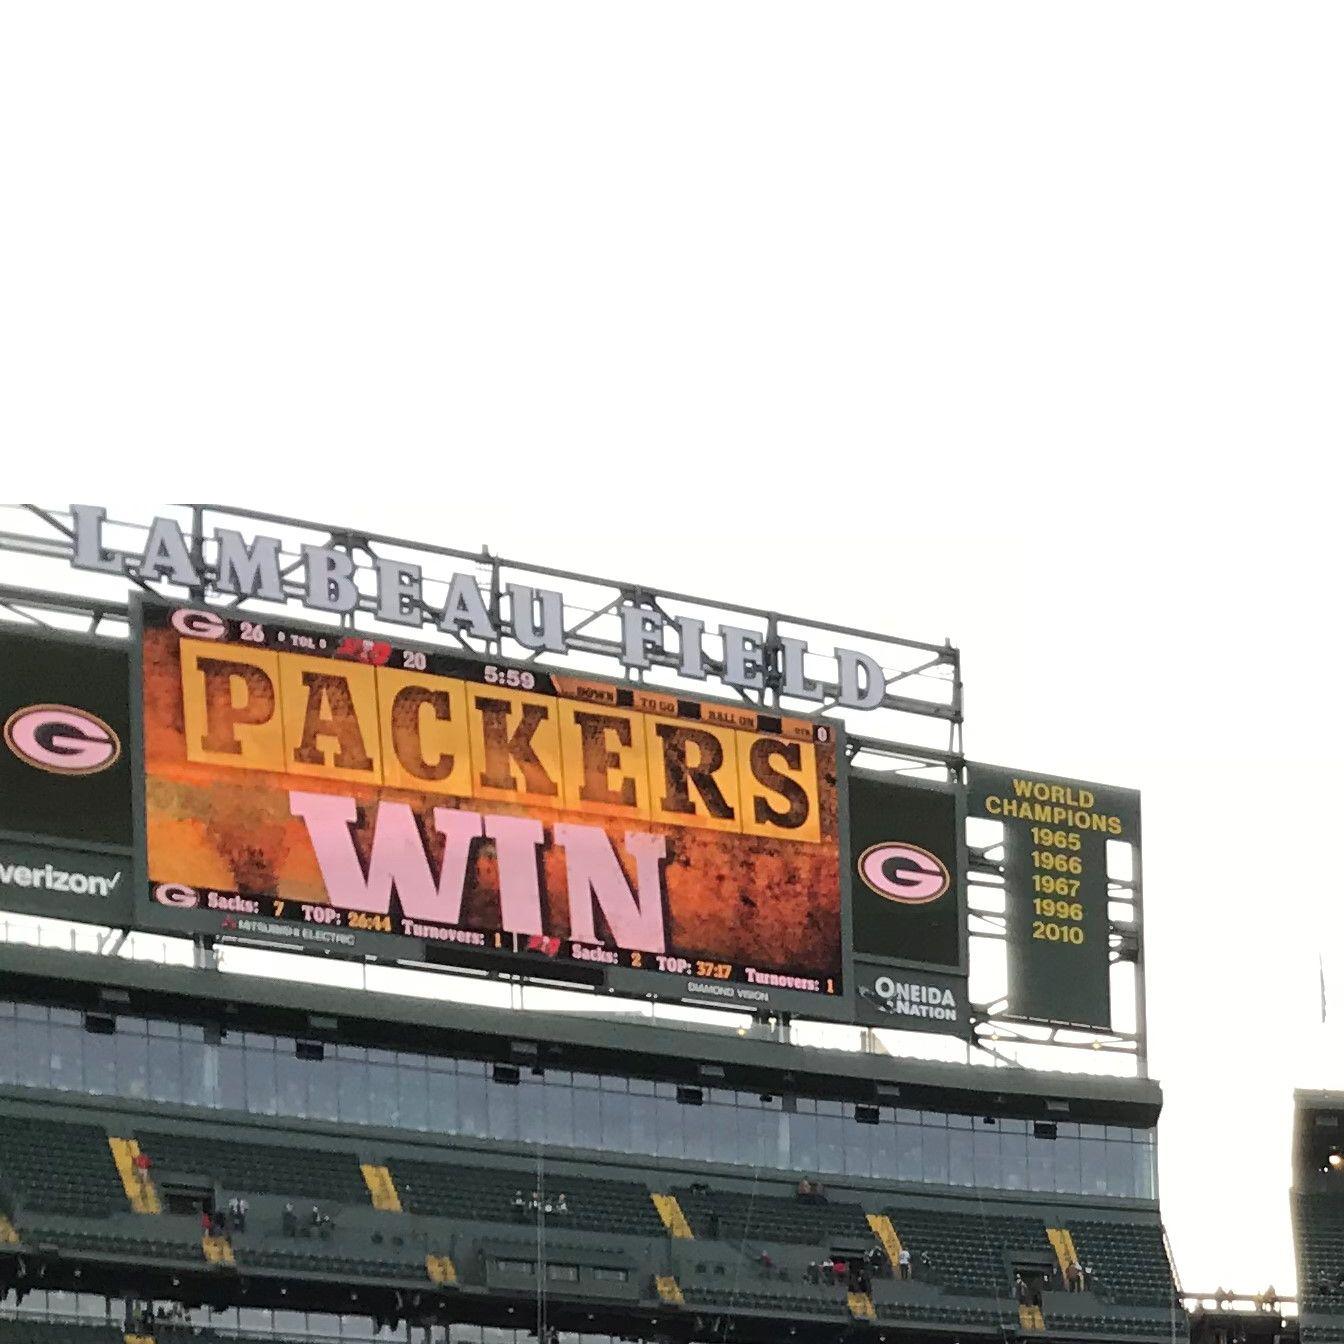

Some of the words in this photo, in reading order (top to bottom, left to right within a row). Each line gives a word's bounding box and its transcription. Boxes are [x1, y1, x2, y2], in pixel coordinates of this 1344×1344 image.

[69, 504, 567, 653] LAMBEAU
[621, 605, 886, 712] FIELD
[239, 621, 265, 643] 26
[403, 651, 427, 671] 20
[484, 665, 535, 690] 5:59
[195, 654, 812, 831] PACKERS
[1013, 778, 1095, 809] WORLD
[985, 796, 1123, 835] CHAMPIONS
[1030, 827, 1082, 851] 1965
[289, 788, 667, 954] WIN
[1031, 851, 1083, 875] 1966
[0, 864, 109, 898] verizon
[1031, 875, 1081, 898] 1967
[301, 904, 342, 926] TOP:
[1032, 898, 1084, 921] 1996
[1032, 921, 1084, 945] 2010
[630, 951, 642, 968] 2
[656, 955, 692, 976] TOP:
[745, 967, 820, 992] Turnovers:
[875, 976, 956, 1007] ONEIDA
[896, 1000, 957, 1021] NATION
